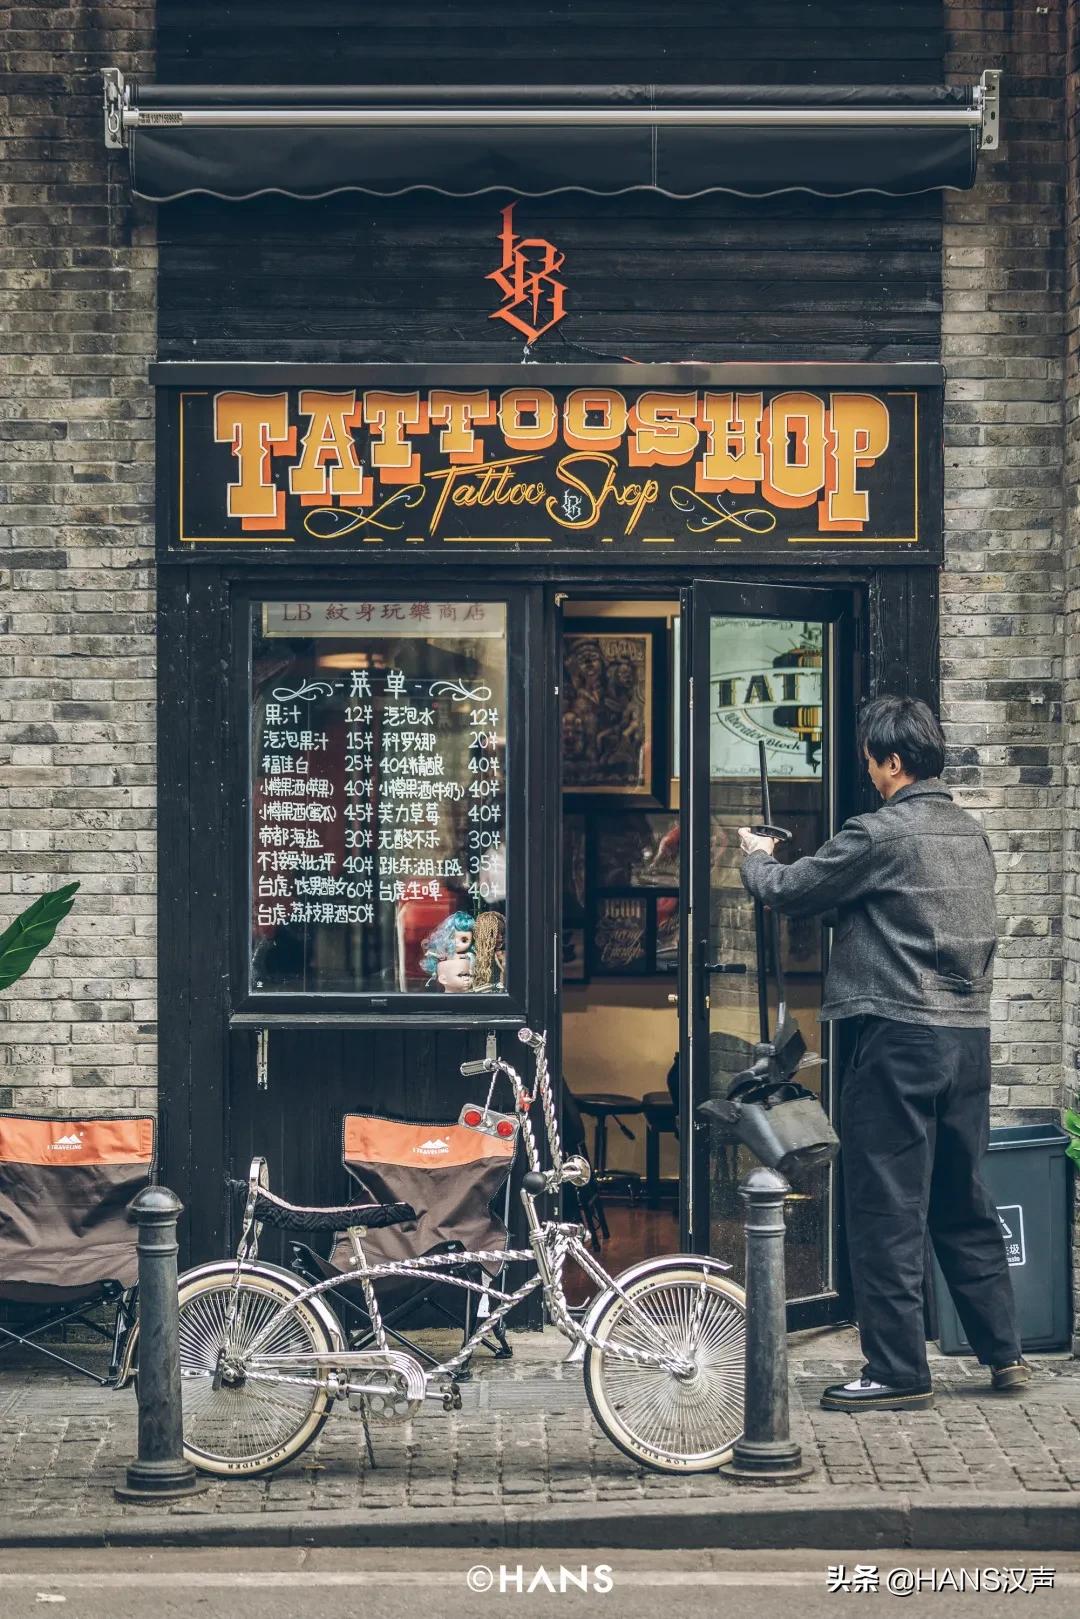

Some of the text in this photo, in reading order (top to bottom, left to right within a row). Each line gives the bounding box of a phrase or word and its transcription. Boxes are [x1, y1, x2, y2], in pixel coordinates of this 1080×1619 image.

[424, 451, 659, 536] Tattoo Shop
[281, 602, 487, 622] LB 紋身玩樂商店
[265, 703, 302, 725] 果汁
[381, 731, 437, 752] 科罗娜
[261, 754, 309, 774] 福佳白
[377, 802, 440, 826] 芙力草莓
[259, 824, 324, 848] 帝都海盐
[257, 849, 337, 872] 不接受批评
